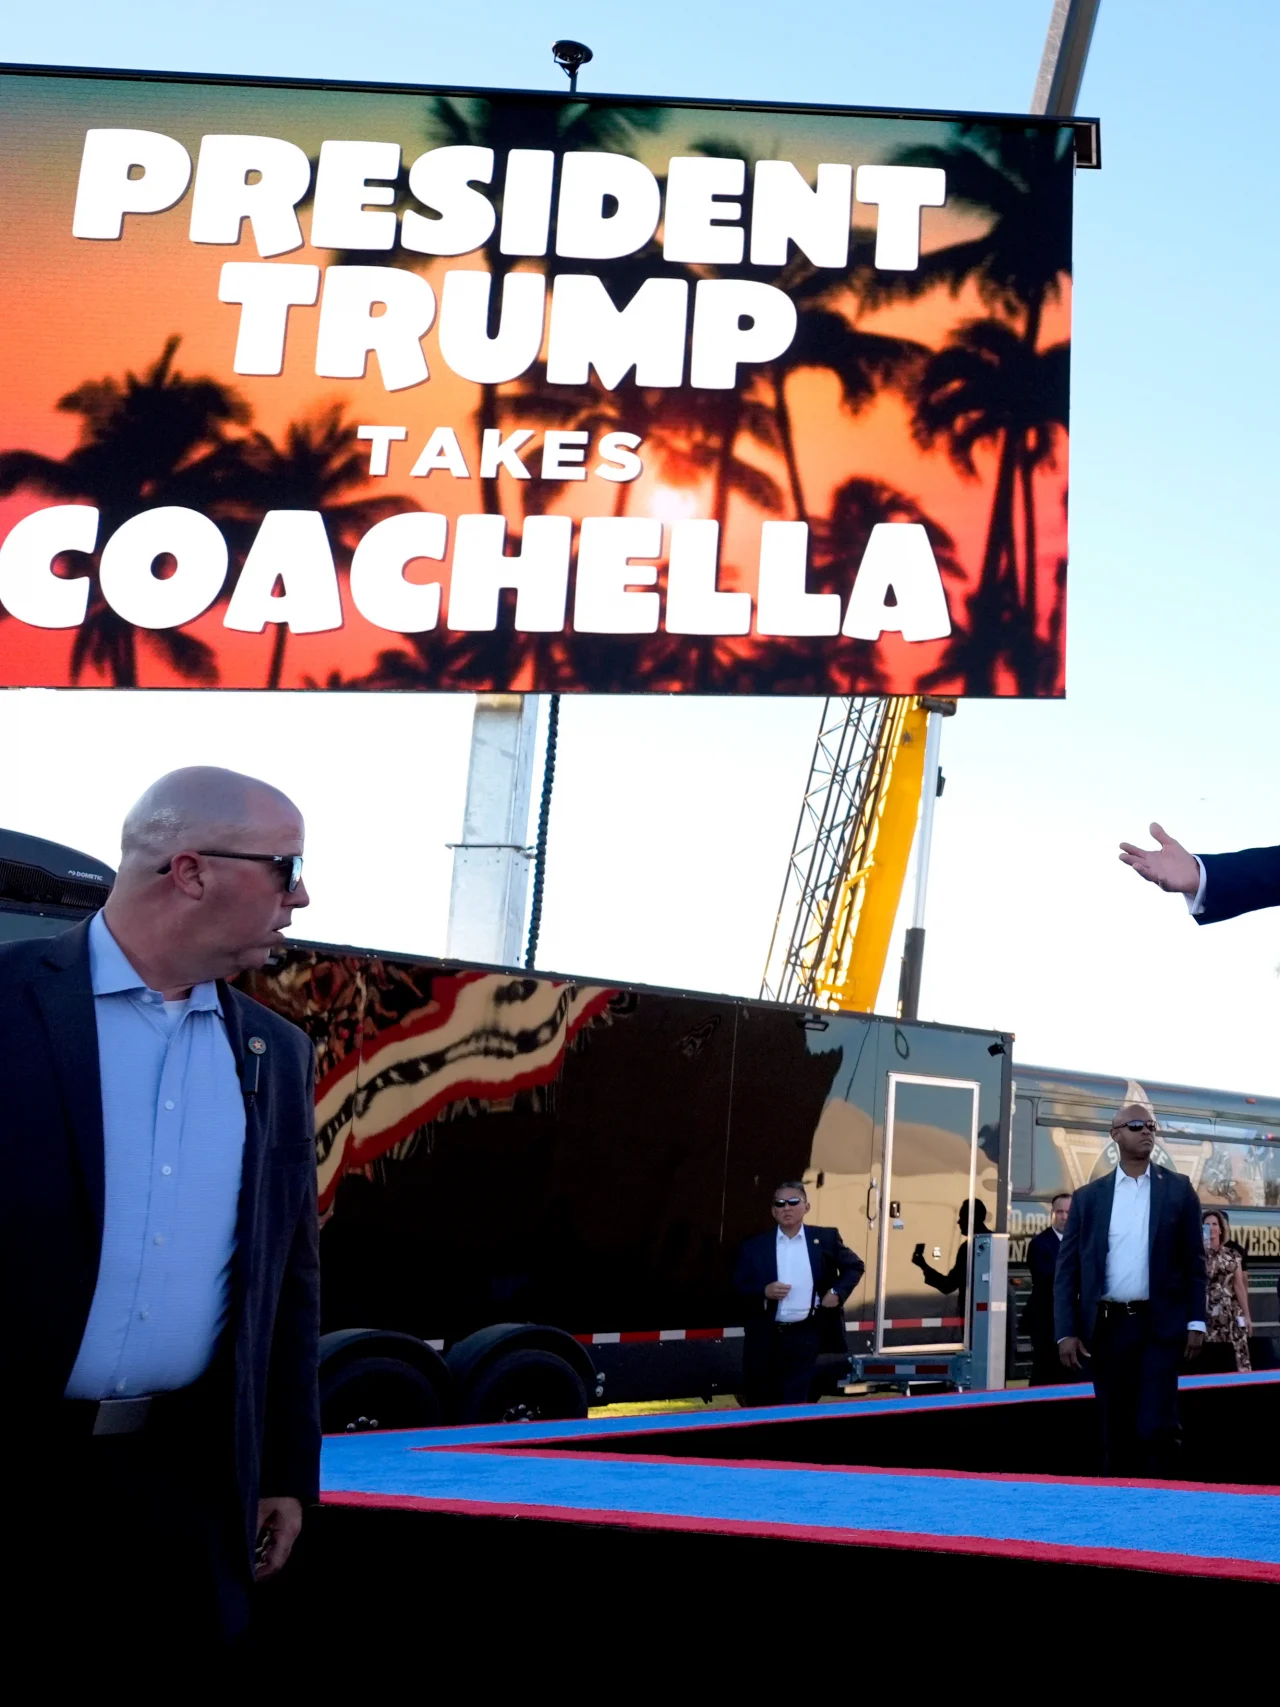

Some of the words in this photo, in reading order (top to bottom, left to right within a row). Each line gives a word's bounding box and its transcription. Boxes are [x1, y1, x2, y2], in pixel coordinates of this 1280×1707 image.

[73, 129, 946, 271] PRESIDENT
[219, 262, 797, 391] TRUMP
[358, 426, 643, 483] TAKES
[0, 504, 951, 642] COACHELLA
[76, 870, 103, 881] DOMETIC
